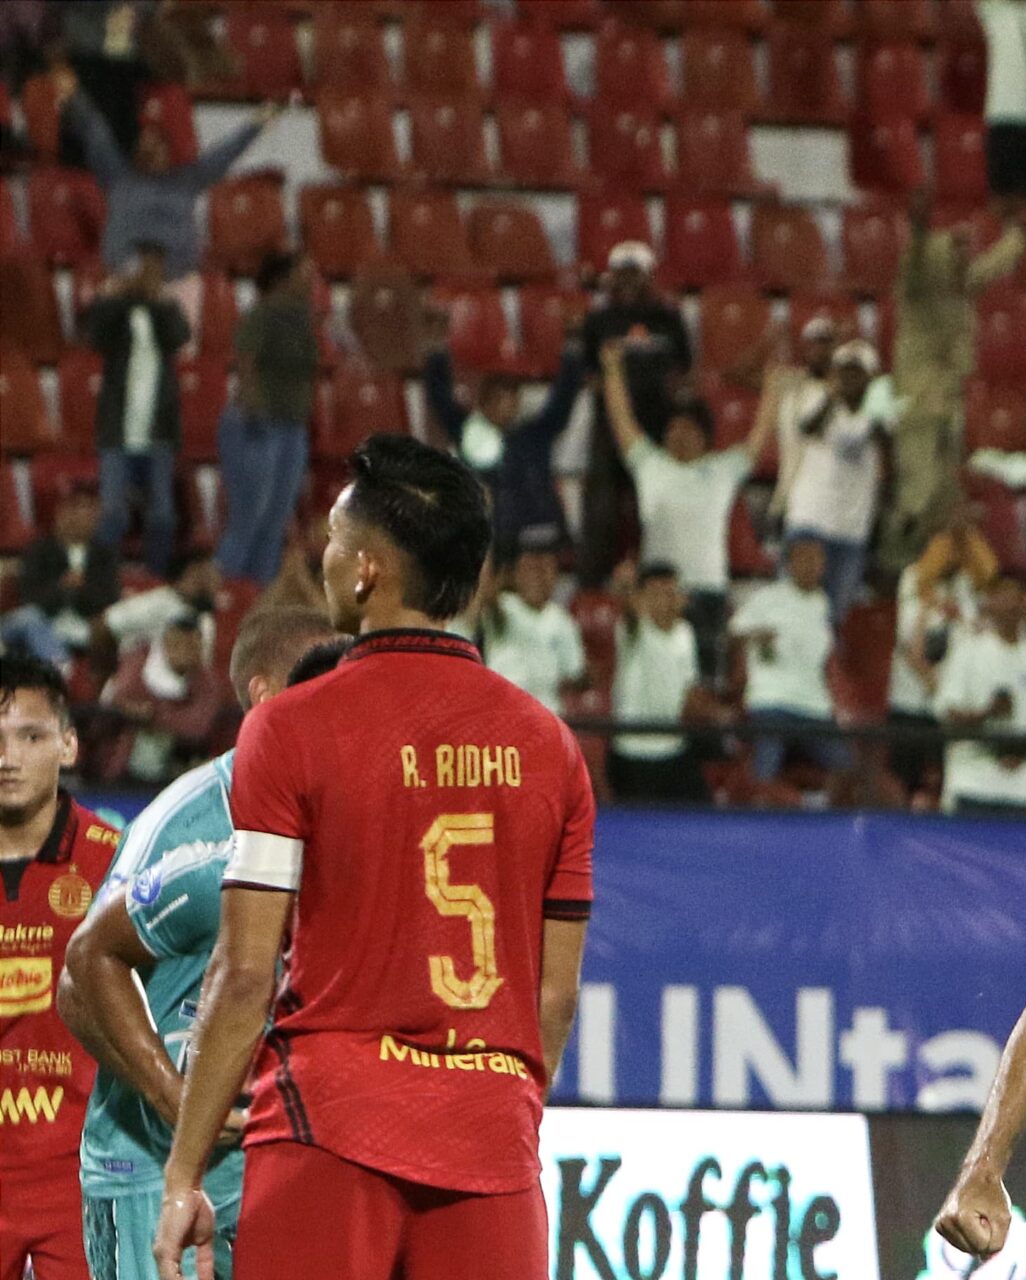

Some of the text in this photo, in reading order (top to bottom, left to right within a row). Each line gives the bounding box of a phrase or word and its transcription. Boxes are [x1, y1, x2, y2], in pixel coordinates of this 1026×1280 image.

[400, 744, 521, 788] R. RIDHO
[418, 812, 504, 1010] 5
